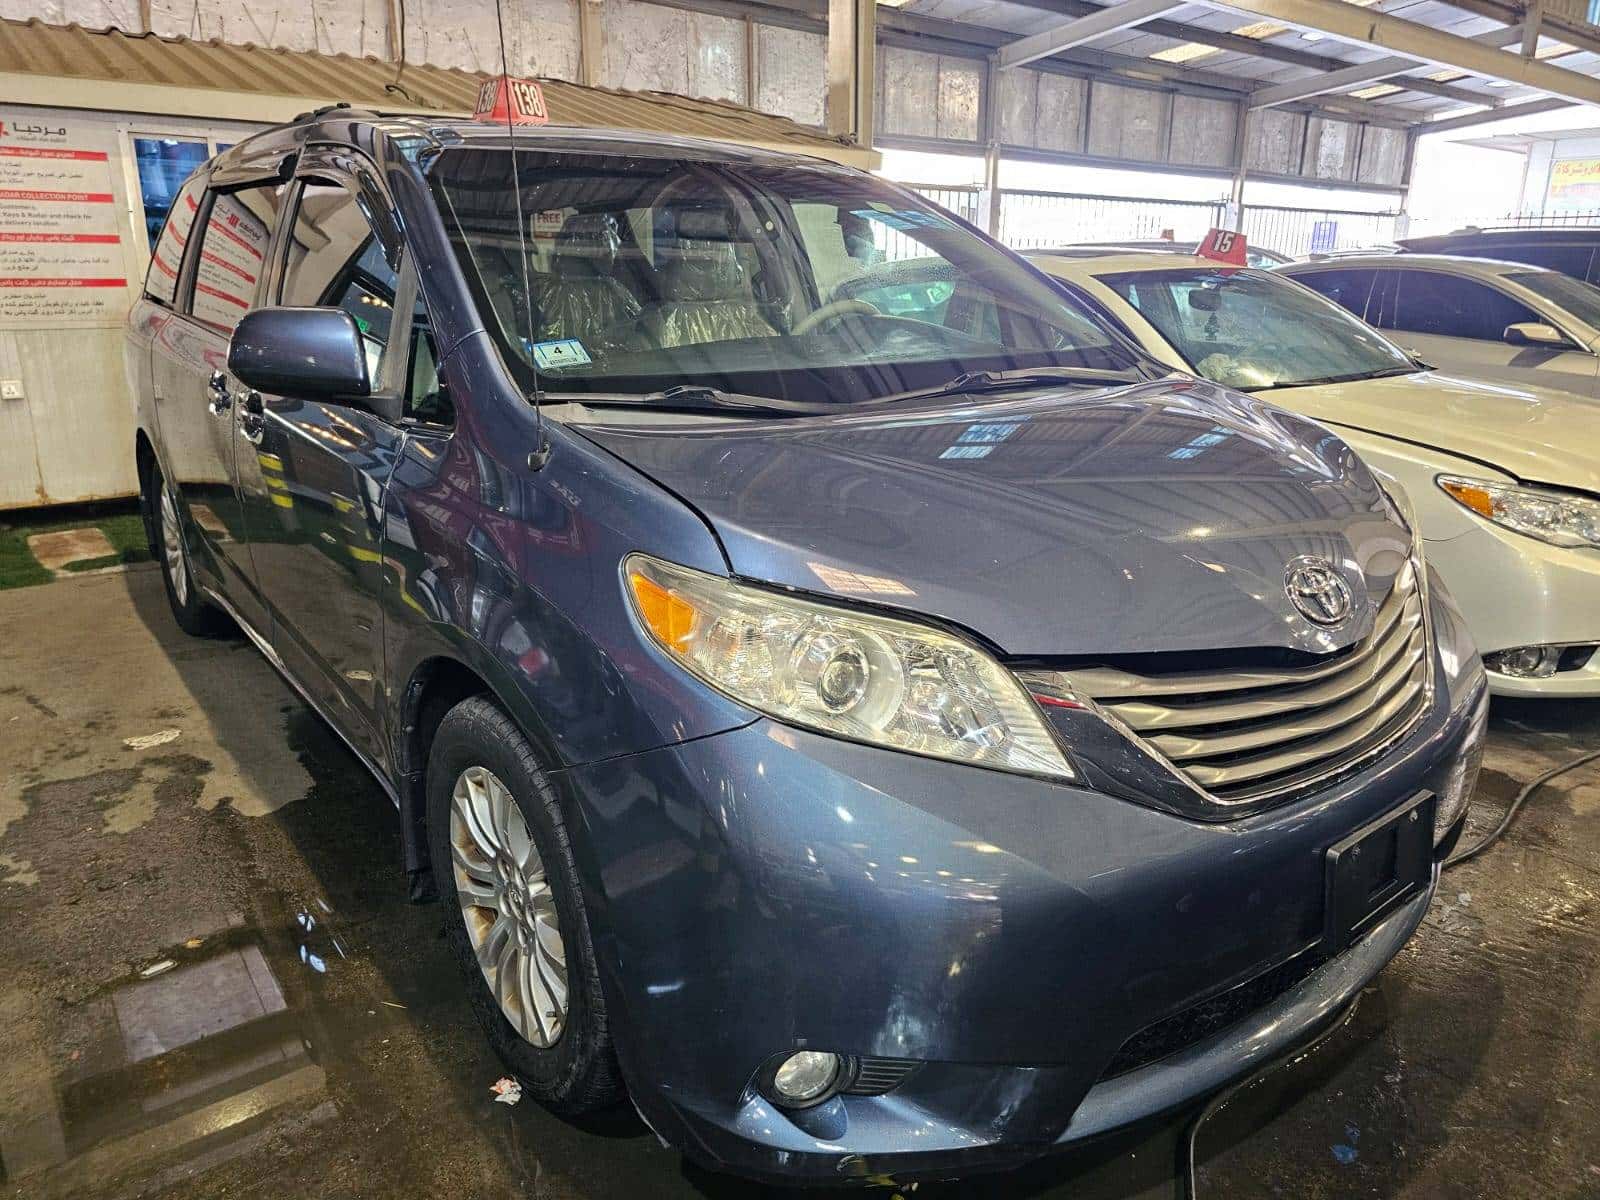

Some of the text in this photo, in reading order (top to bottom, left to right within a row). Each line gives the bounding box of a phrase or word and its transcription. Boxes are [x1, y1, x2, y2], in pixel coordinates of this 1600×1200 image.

[514, 83, 543, 117] 138
[21, 192, 65, 201] COLLECTION
[67, 193, 88, 201] POINT
[537, 213, 561, 224] FREE
[1214, 232, 1235, 253] 15
[553, 346, 563, 354] 4
